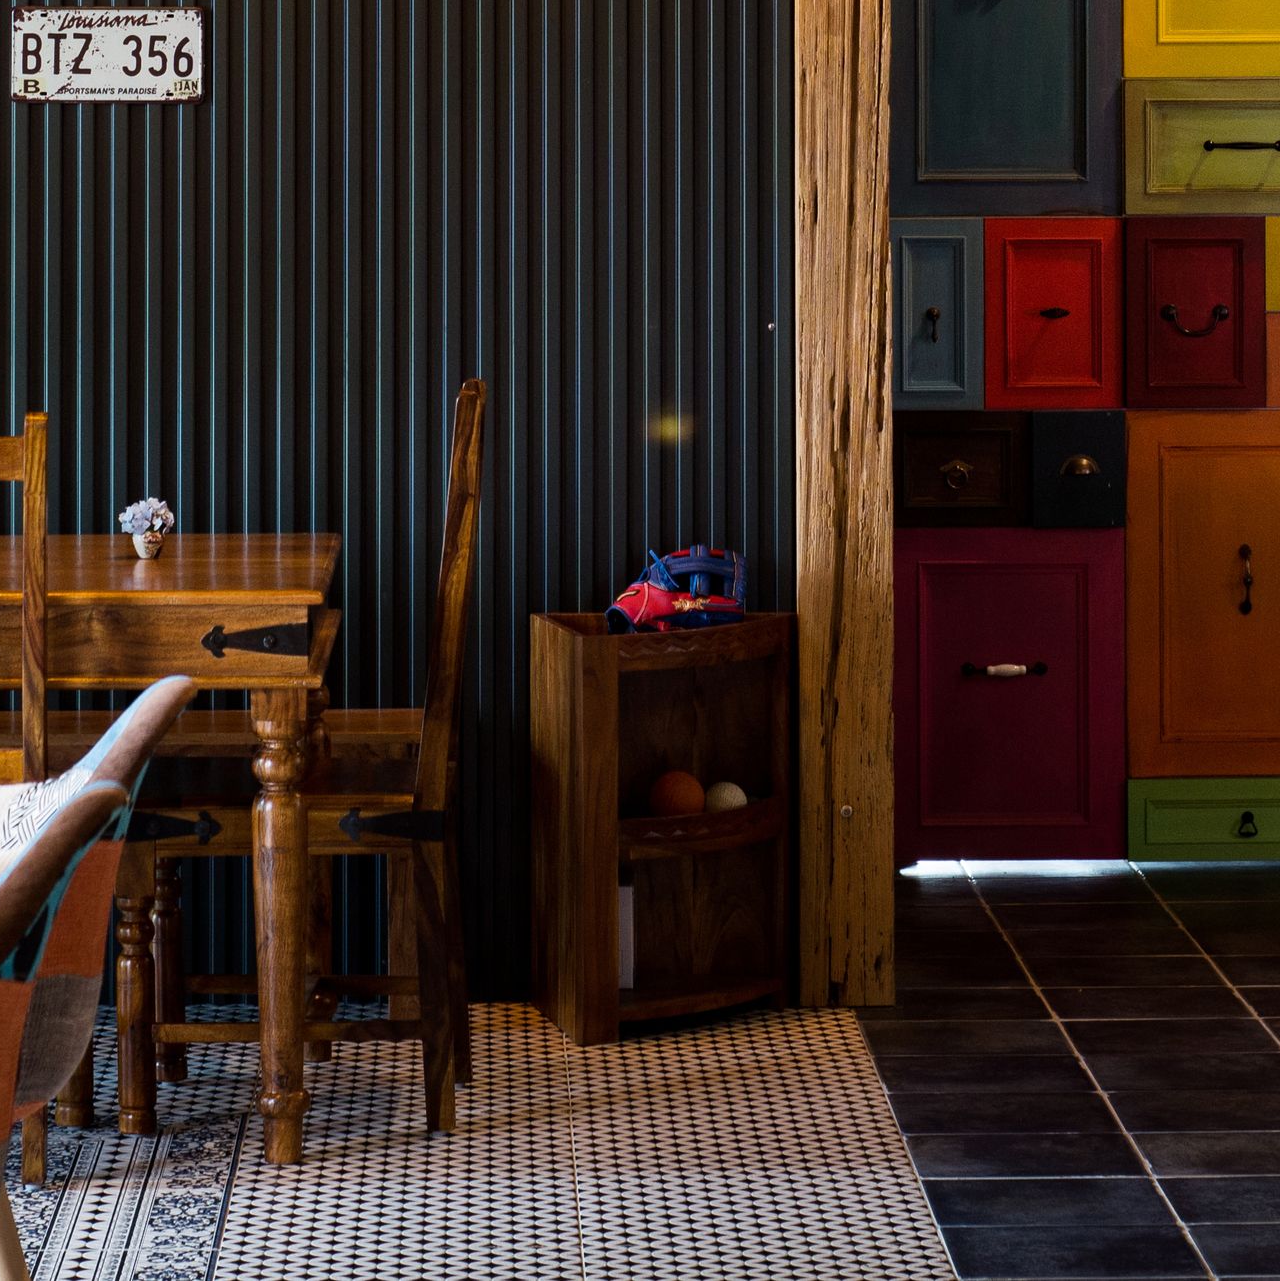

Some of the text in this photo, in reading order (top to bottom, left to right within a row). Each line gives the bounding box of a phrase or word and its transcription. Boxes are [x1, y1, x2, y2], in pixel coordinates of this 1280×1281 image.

[58, 12, 158, 32] Louisiana
[21, 32, 194, 78] BTZ 356
[23, 79, 41, 94] B
[117, 87, 158, 95] PARADISE
[178, 80, 198, 92] JAN
